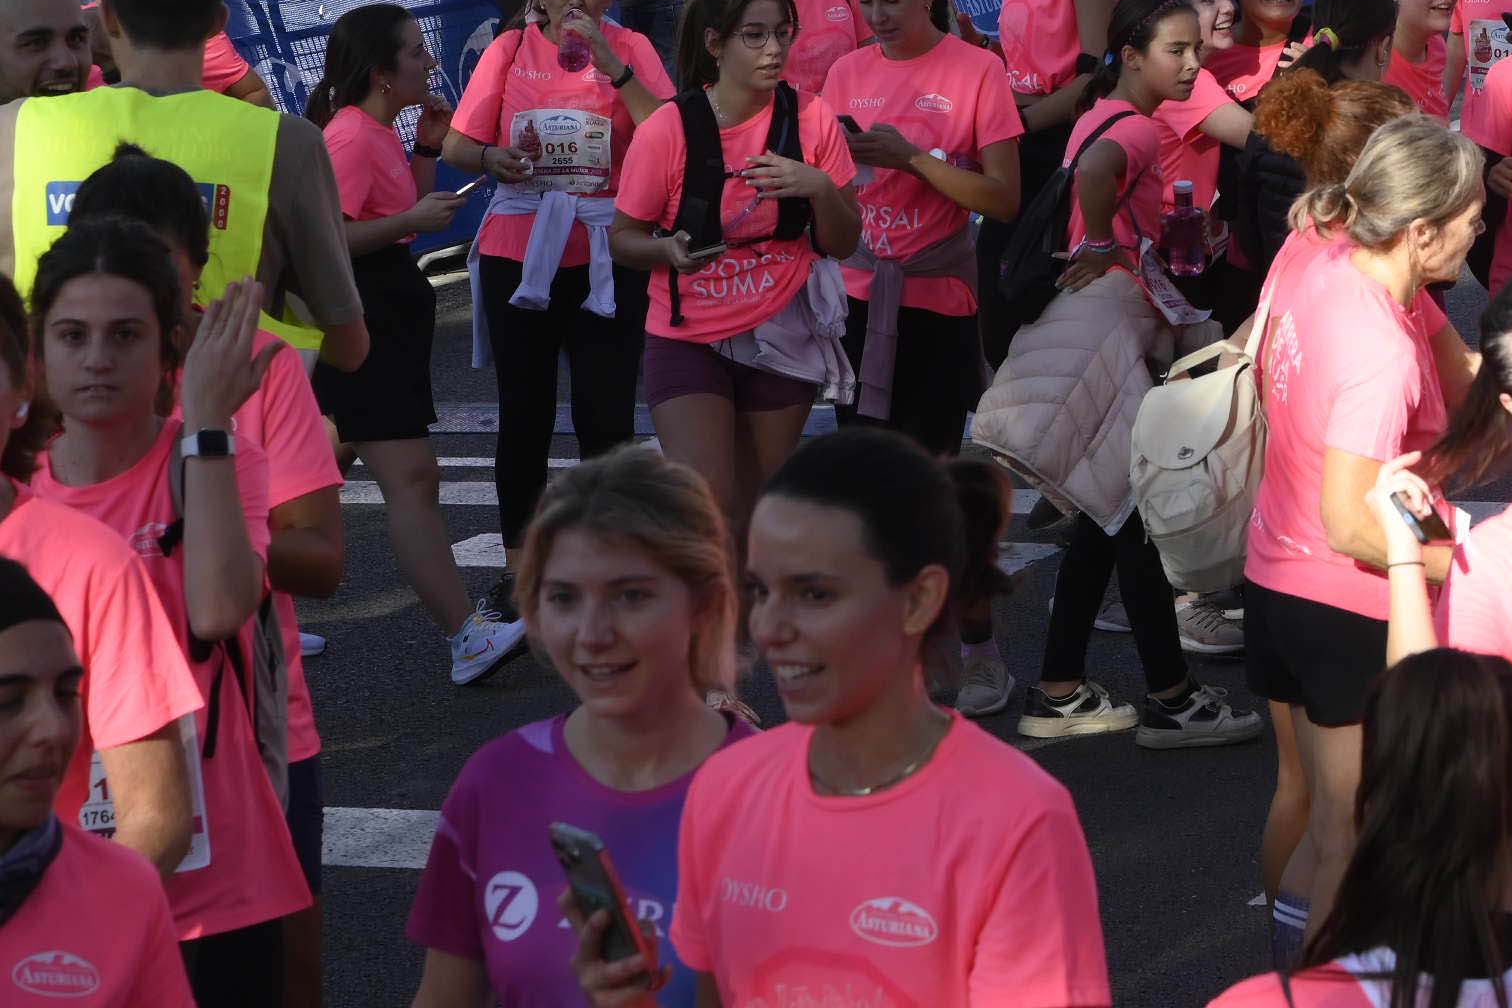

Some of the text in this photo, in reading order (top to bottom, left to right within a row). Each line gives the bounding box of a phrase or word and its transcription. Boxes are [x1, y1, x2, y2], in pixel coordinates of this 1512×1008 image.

[849, 97, 885, 109] OYSHO
[545, 141, 578, 154] 016
[692, 271, 776, 298] SUMA
[858, 910, 930, 937] ASTURIANA
[22, 966, 96, 988] ASTURIANA
